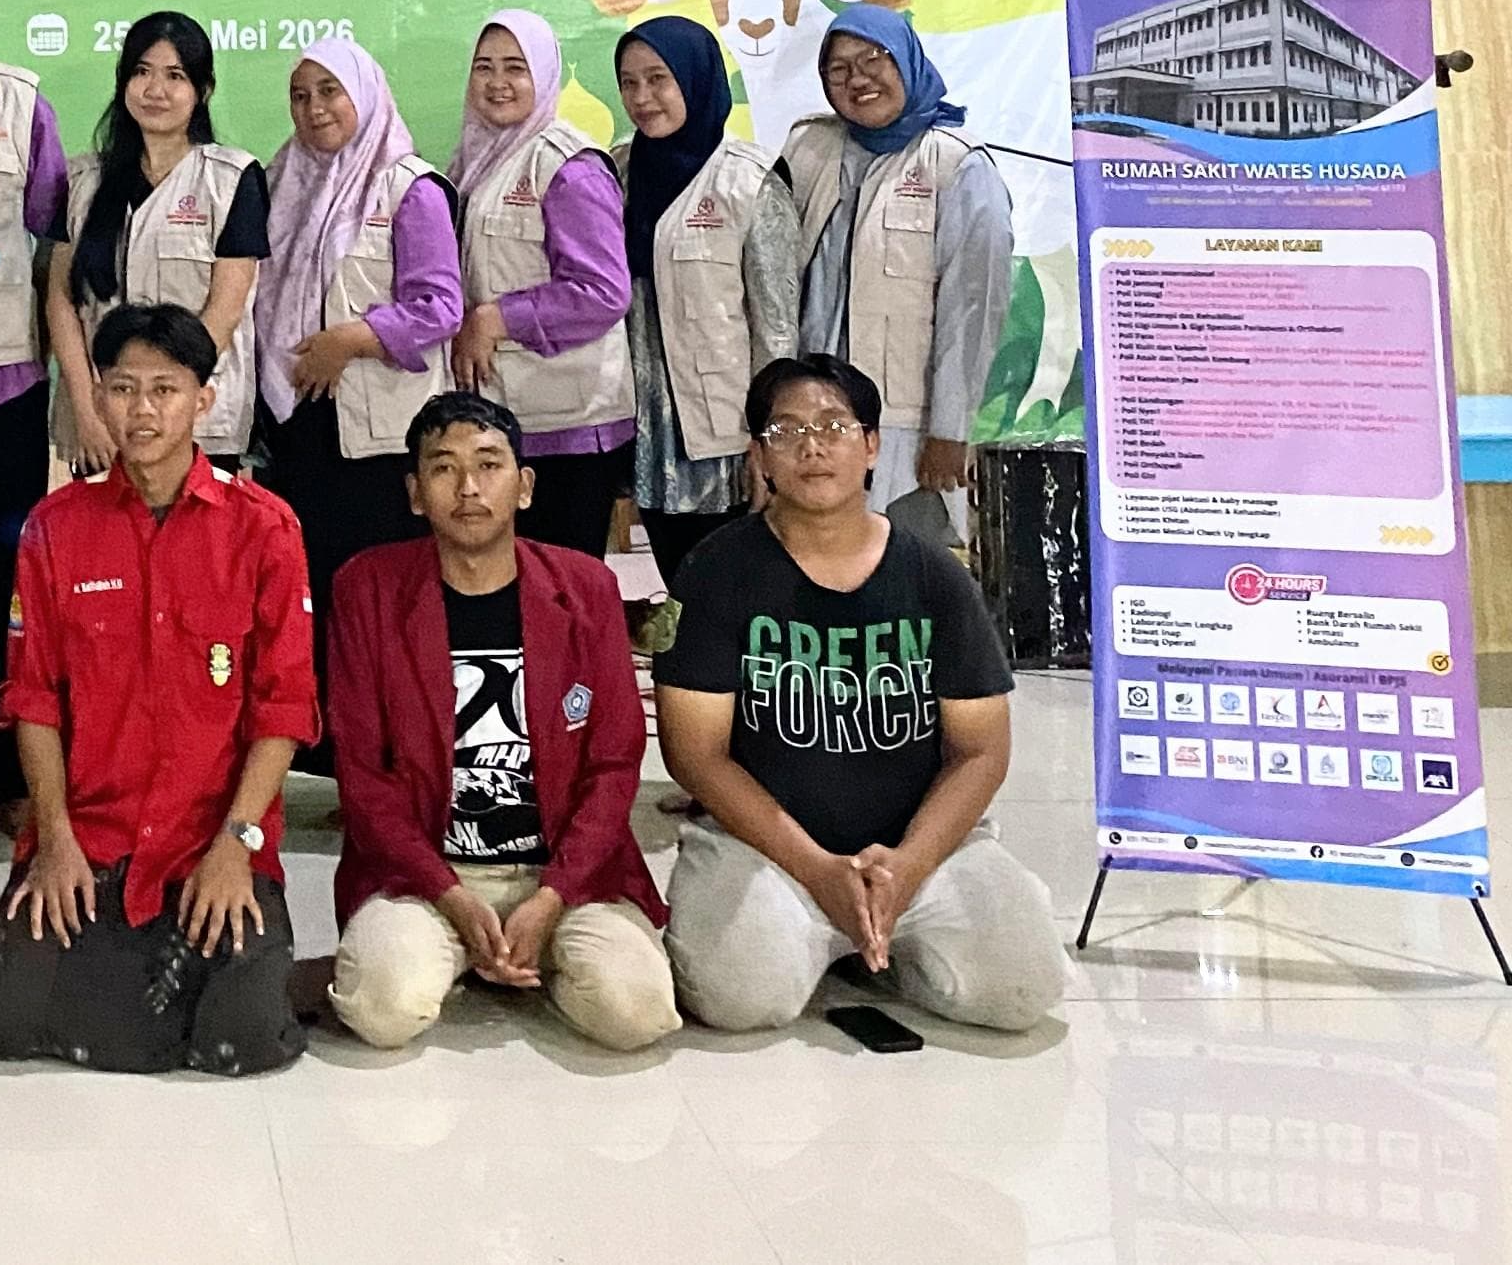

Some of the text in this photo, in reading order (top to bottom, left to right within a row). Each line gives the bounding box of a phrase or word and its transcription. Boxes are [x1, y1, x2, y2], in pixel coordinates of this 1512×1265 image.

[210, 18, 267, 51] Mei
[1101, 162, 1406, 180] RUMAH SAKIT WATES HUSADA
[1205, 238, 1279, 251] LAYANAN
[1256, 578, 1321, 591] 24 HOURS
[748, 615, 933, 697] GREEN
[741, 654, 937, 753] FORCE
